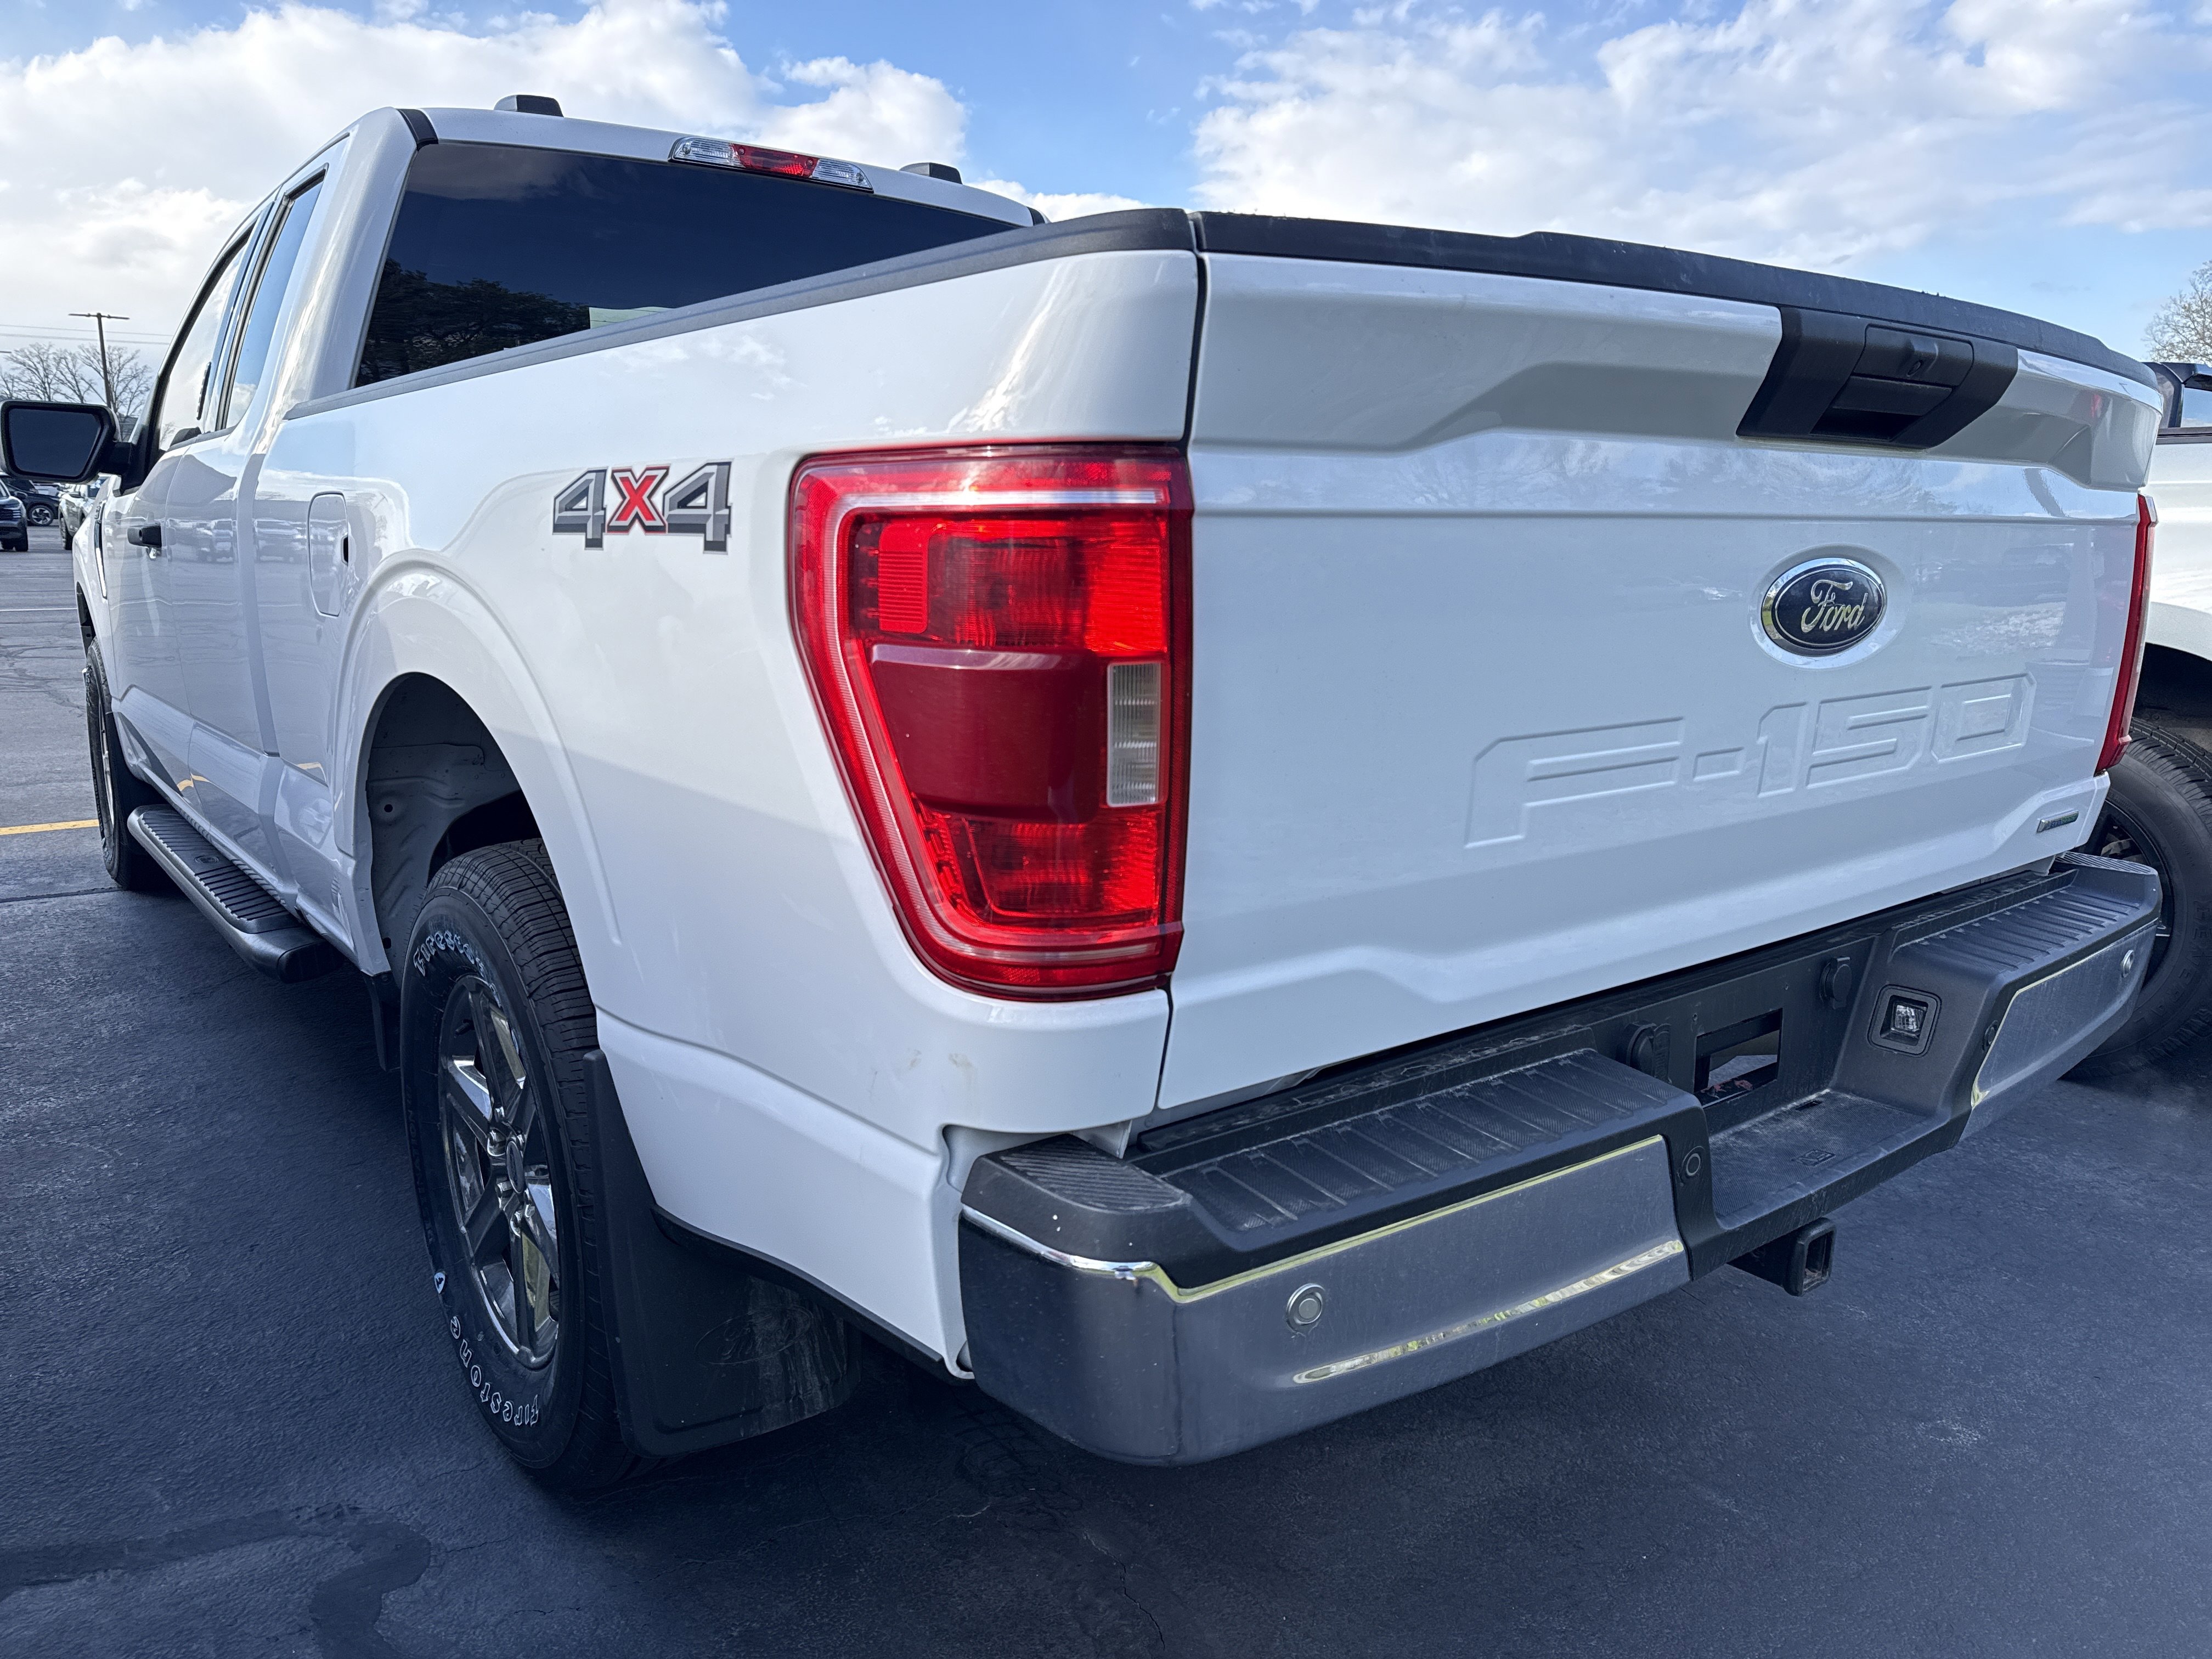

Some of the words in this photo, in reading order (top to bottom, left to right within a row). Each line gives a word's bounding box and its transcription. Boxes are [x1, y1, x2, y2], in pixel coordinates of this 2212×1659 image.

[1801, 579, 1869, 633] Ford
[1464, 671, 2037, 848] F-150
[449, 1315, 539, 1427] Firestone
